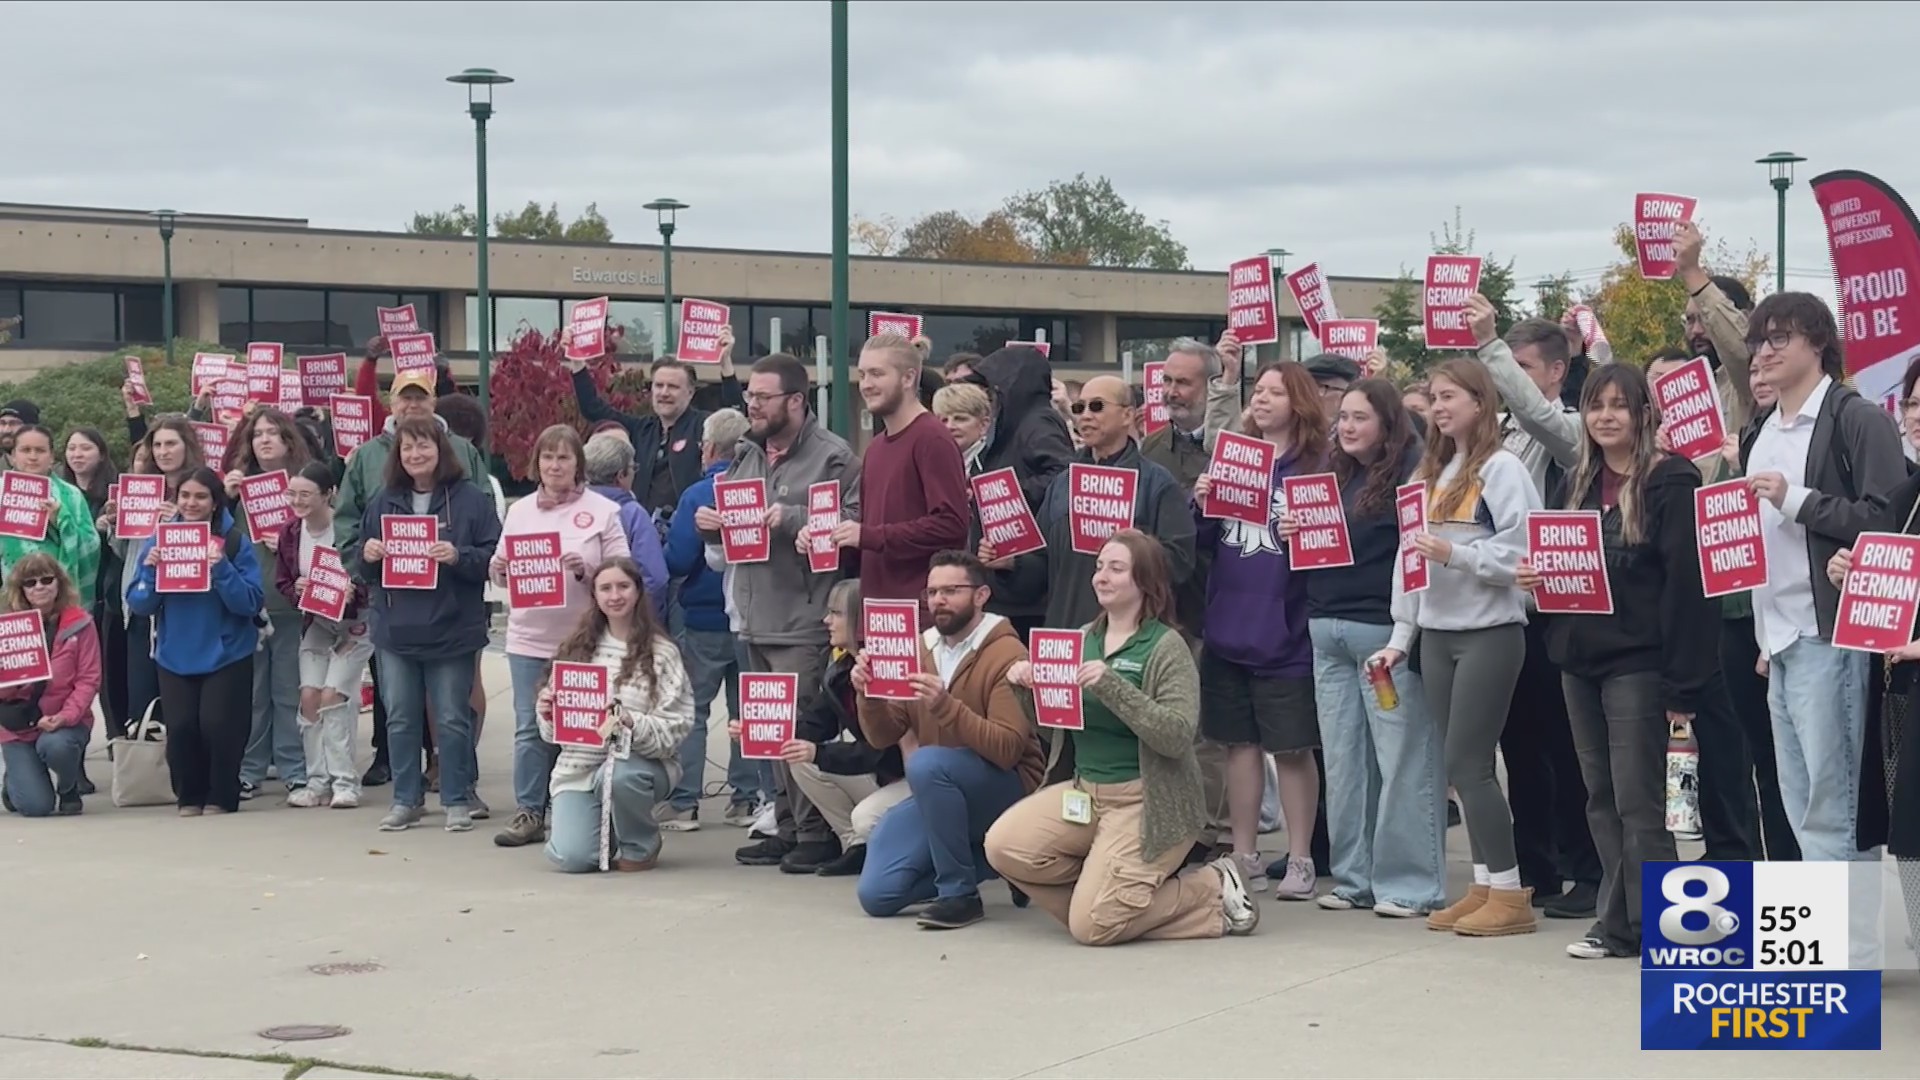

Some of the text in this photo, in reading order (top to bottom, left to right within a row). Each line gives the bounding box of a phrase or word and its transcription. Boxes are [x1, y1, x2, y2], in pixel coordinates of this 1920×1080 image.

[1643, 200, 1684, 219] BRING
[1830, 197, 1861, 217] UNITED
[1832, 208, 1881, 233] UNIVERSITY
[1638, 222, 1676, 240] GERMA
[1834, 224, 1894, 249] PROFESSIONS
[573, 266, 637, 284] Edwards
[1233, 264, 1262, 286] BRING
[1433, 263, 1470, 283] BRING
[1230, 284, 1270, 308] GERMAN
[384, 310, 409, 321] BRING
[574, 304, 601, 320] BRING
[689, 305, 721, 322] BRING
[1231, 306, 1267, 329] HOME!
[1432, 310, 1467, 330] HOME!
[1873, 306, 1902, 338] BE
[686, 336, 717, 352] HOME!
[1328, 327, 1366, 345] BRING
[398, 340, 427, 354] BRING
[306, 360, 338, 373] BRING
[396, 353, 434, 368] GERMAN
[303, 374, 344, 386] GERMAN
[1661, 370, 1700, 404] BRING
[281, 386, 301, 399] ERM
[280, 402, 302, 413] HOM
[336, 402, 363, 417] BRING
[1662, 390, 1714, 427] GERMAN
[334, 417, 368, 433] GERMAN
[1670, 415, 1713, 449] HOME!
[1223, 440, 1264, 467] BRING
[1081, 473, 1124, 497] BRING
[1212, 461, 1268, 490] GERMAN
[11, 478, 43, 495] BRING
[127, 480, 156, 494] BRING
[247, 478, 280, 497] BRING
[1216, 484, 1259, 509] HOME!
[1292, 483, 1329, 505] BRING
[723, 487, 757, 507] BRING
[1705, 488, 1748, 519] BRING
[5, 509, 40, 526] HOME!
[721, 507, 764, 527] GERMAN
[1073, 496, 1129, 520] GERMAN
[1290, 505, 1342, 527] GERMAN
[125, 512, 154, 526] HOME!
[254, 508, 288, 529] HOME!
[165, 528, 200, 544] BRING
[391, 522, 427, 537] BRING
[729, 527, 762, 547] HOME!
[1300, 528, 1340, 550] HOME!
[1540, 525, 1587, 546] BRING
[1701, 514, 1759, 547] GERMAN
[160, 546, 206, 561] GERMAN
[513, 538, 553, 557] BRING
[1860, 543, 1914, 572] BRING
[392, 558, 429, 574] HOME!
[510, 557, 561, 576] GERMAN
[1533, 550, 1599, 572] GERMAN
[1710, 543, 1757, 574] HOME!
[165, 563, 201, 578] HOME!
[516, 576, 557, 595] HOME!
[1542, 575, 1596, 595] HOME!
[1848, 570, 1919, 602] GERMAN
[869, 612, 906, 633] BRING
[1849, 600, 1902, 630] HOME!
[865, 635, 914, 657] GERMAN
[1038, 638, 1073, 660] BRING
[3, 653, 39, 670] HOME!
[871, 657, 909, 680] HOME!
[562, 670, 598, 689] BRING
[1033, 663, 1078, 685] GERMAN
[749, 680, 786, 699] BRING
[1040, 686, 1073, 709] HOME!
[556, 690, 605, 710] GERMAN
[562, 710, 599, 730] HOME!
[743, 702, 791, 721] GERMAN
[749, 723, 784, 742] HOME!
